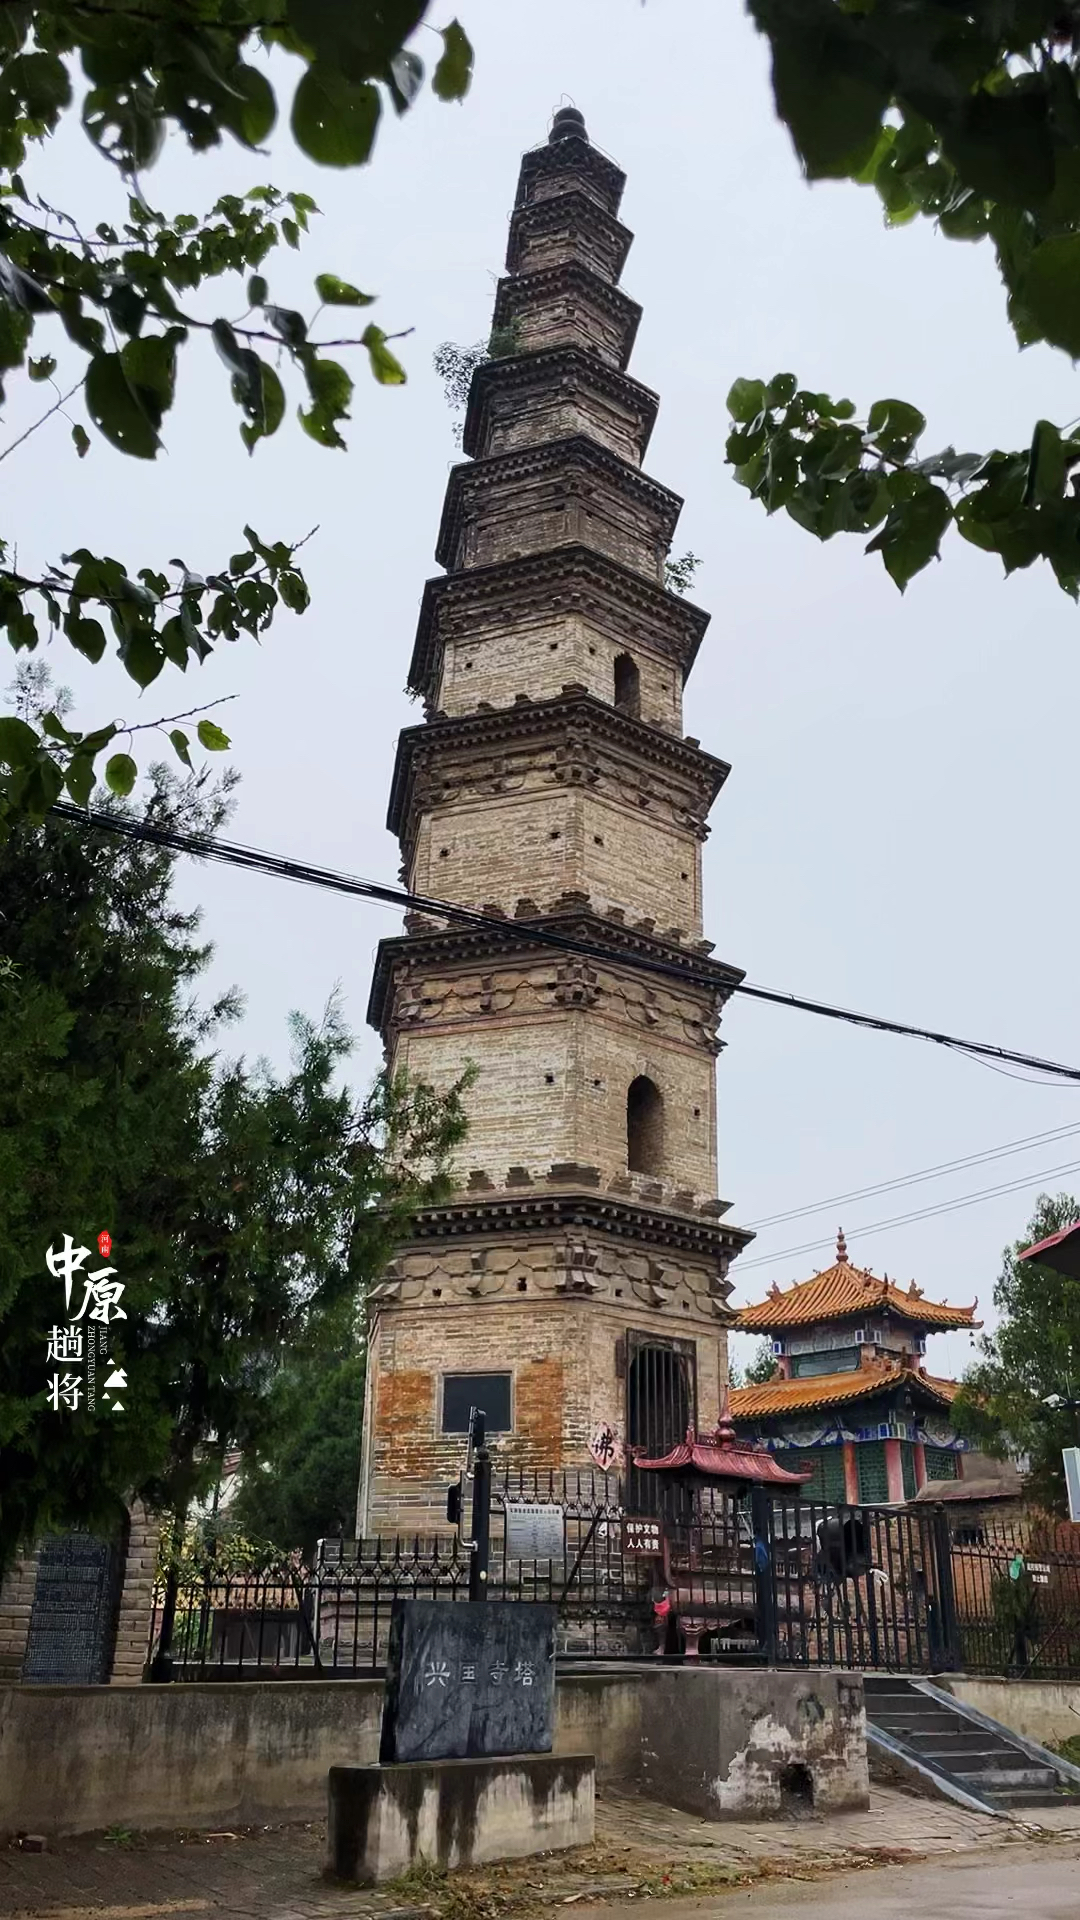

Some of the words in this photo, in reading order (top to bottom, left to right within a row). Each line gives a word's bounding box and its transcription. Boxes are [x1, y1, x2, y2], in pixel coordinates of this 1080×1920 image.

[592, 1429, 615, 1465] 佛
[626, 1523, 659, 1534] 保护文物
[626, 1538, 659, 1550] 人人有责
[425, 1660, 536, 1687] 兴国寺塔
